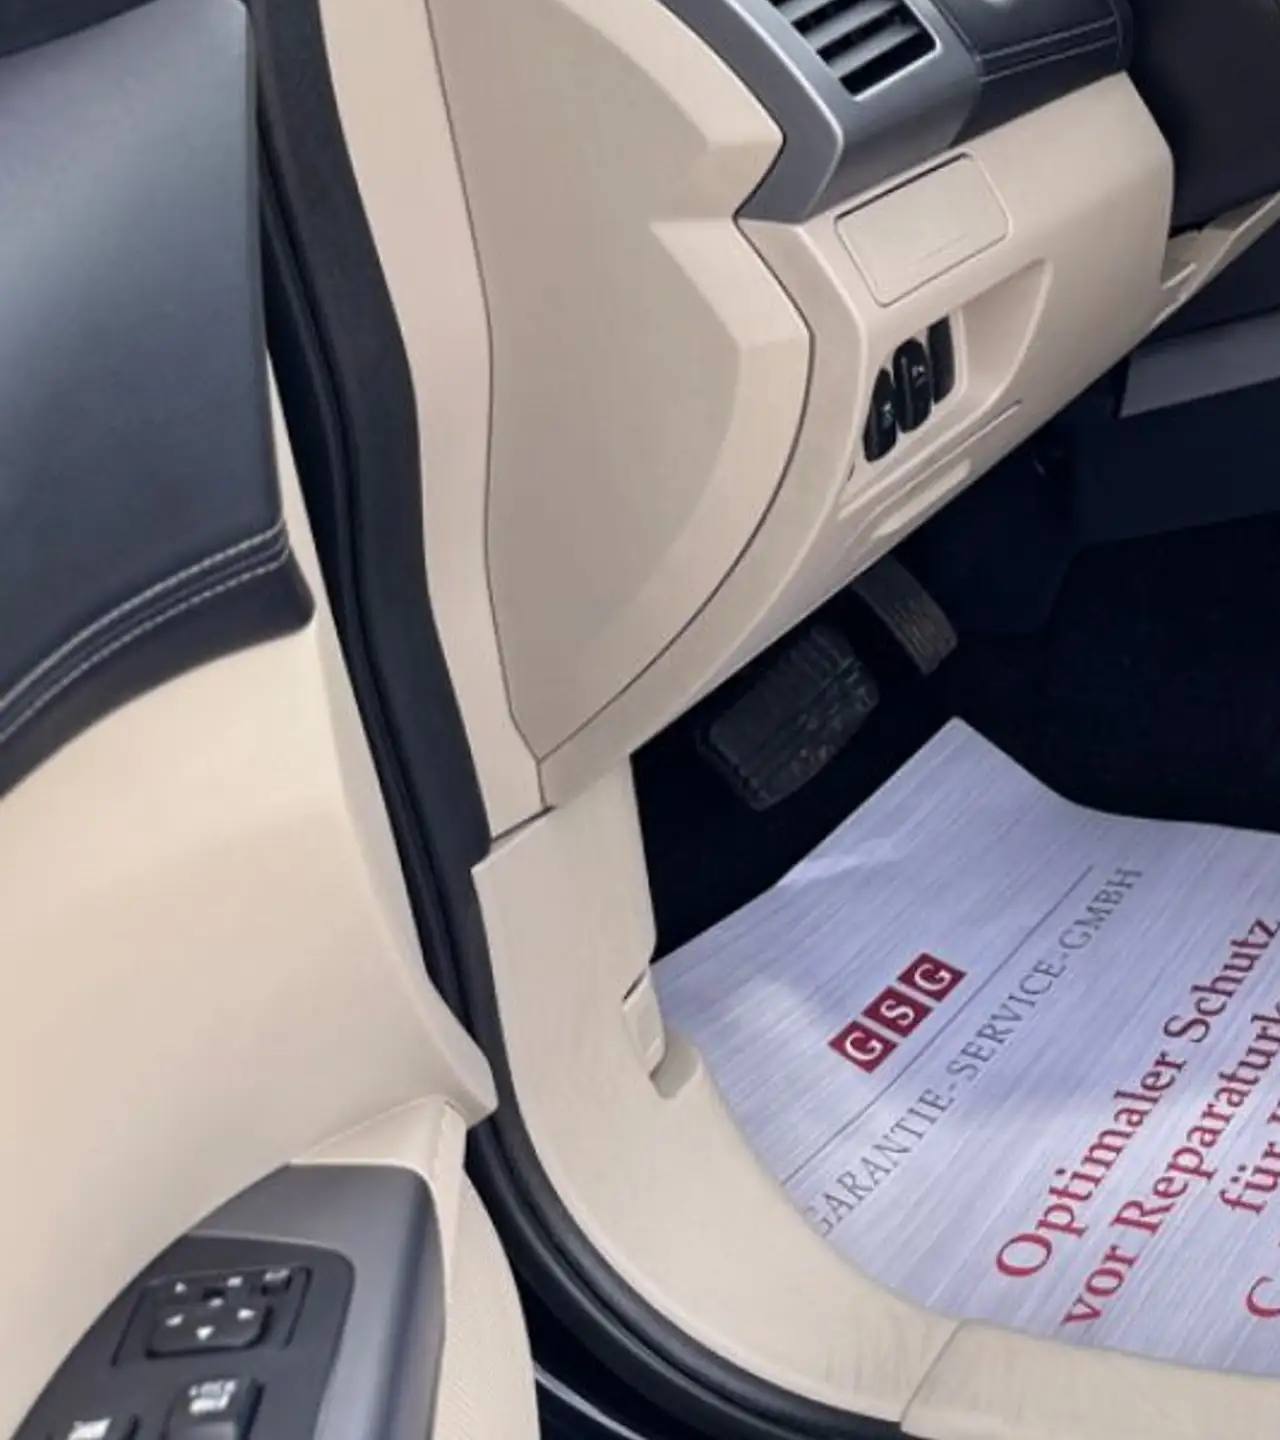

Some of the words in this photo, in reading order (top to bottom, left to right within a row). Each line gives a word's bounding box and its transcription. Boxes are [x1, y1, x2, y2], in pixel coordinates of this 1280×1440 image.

[841, 958, 956, 1067] GSG
[995, 1049, 1188, 1278] Optimaler
[1061, 1243, 1140, 1327] vor
